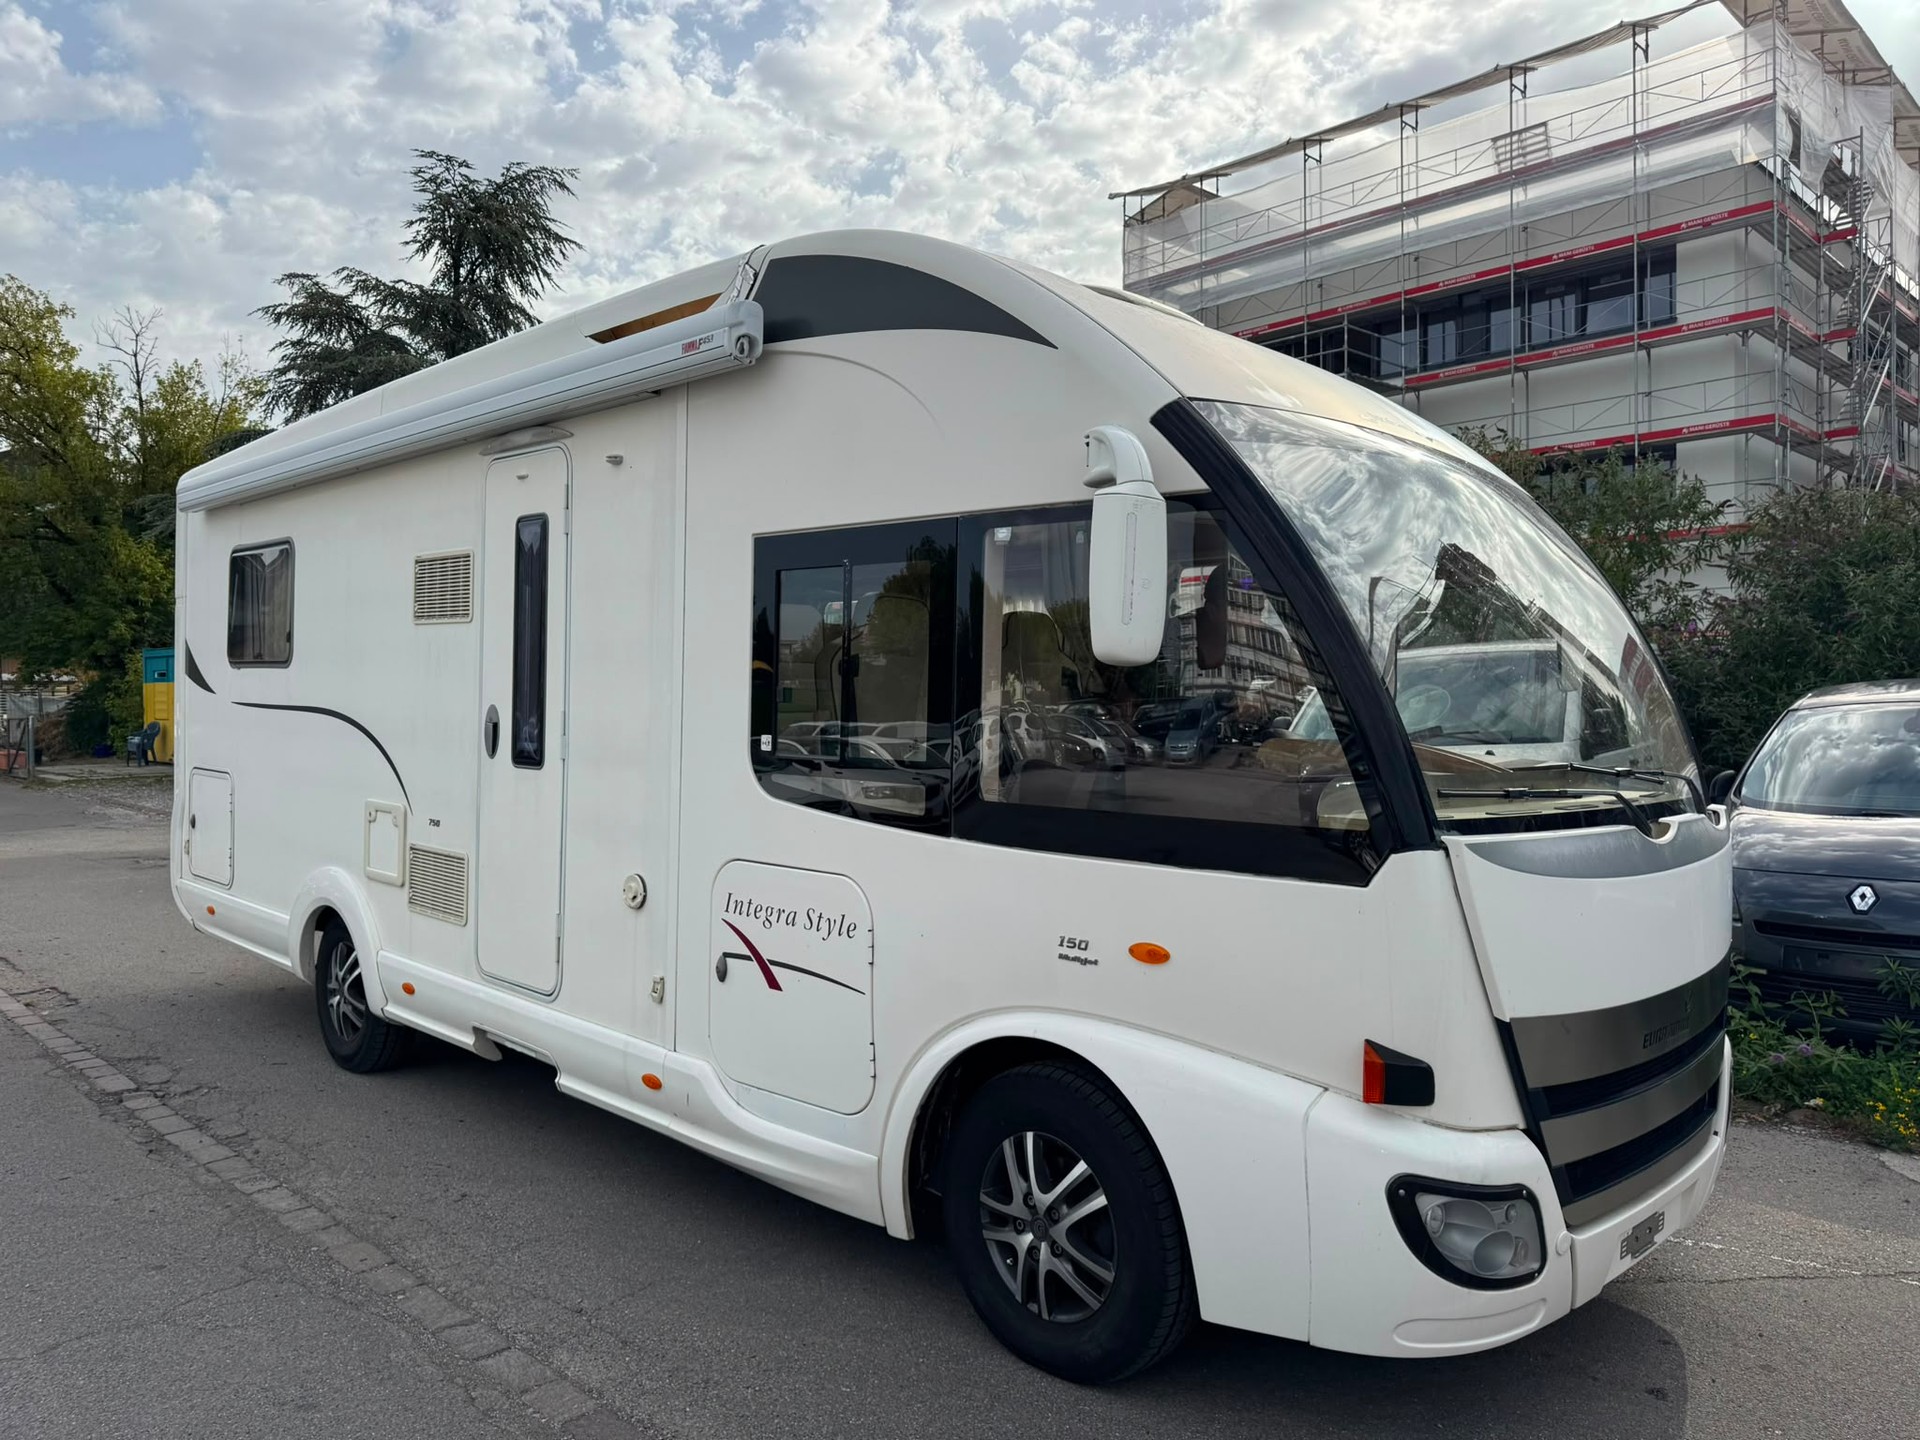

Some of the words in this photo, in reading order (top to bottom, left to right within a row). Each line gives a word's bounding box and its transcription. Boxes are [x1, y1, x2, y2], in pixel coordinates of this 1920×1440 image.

[428, 818, 441, 828] 750
[724, 892, 798, 930] Integra
[803, 907, 857, 942] Style
[1057, 935, 1090, 951] 150
